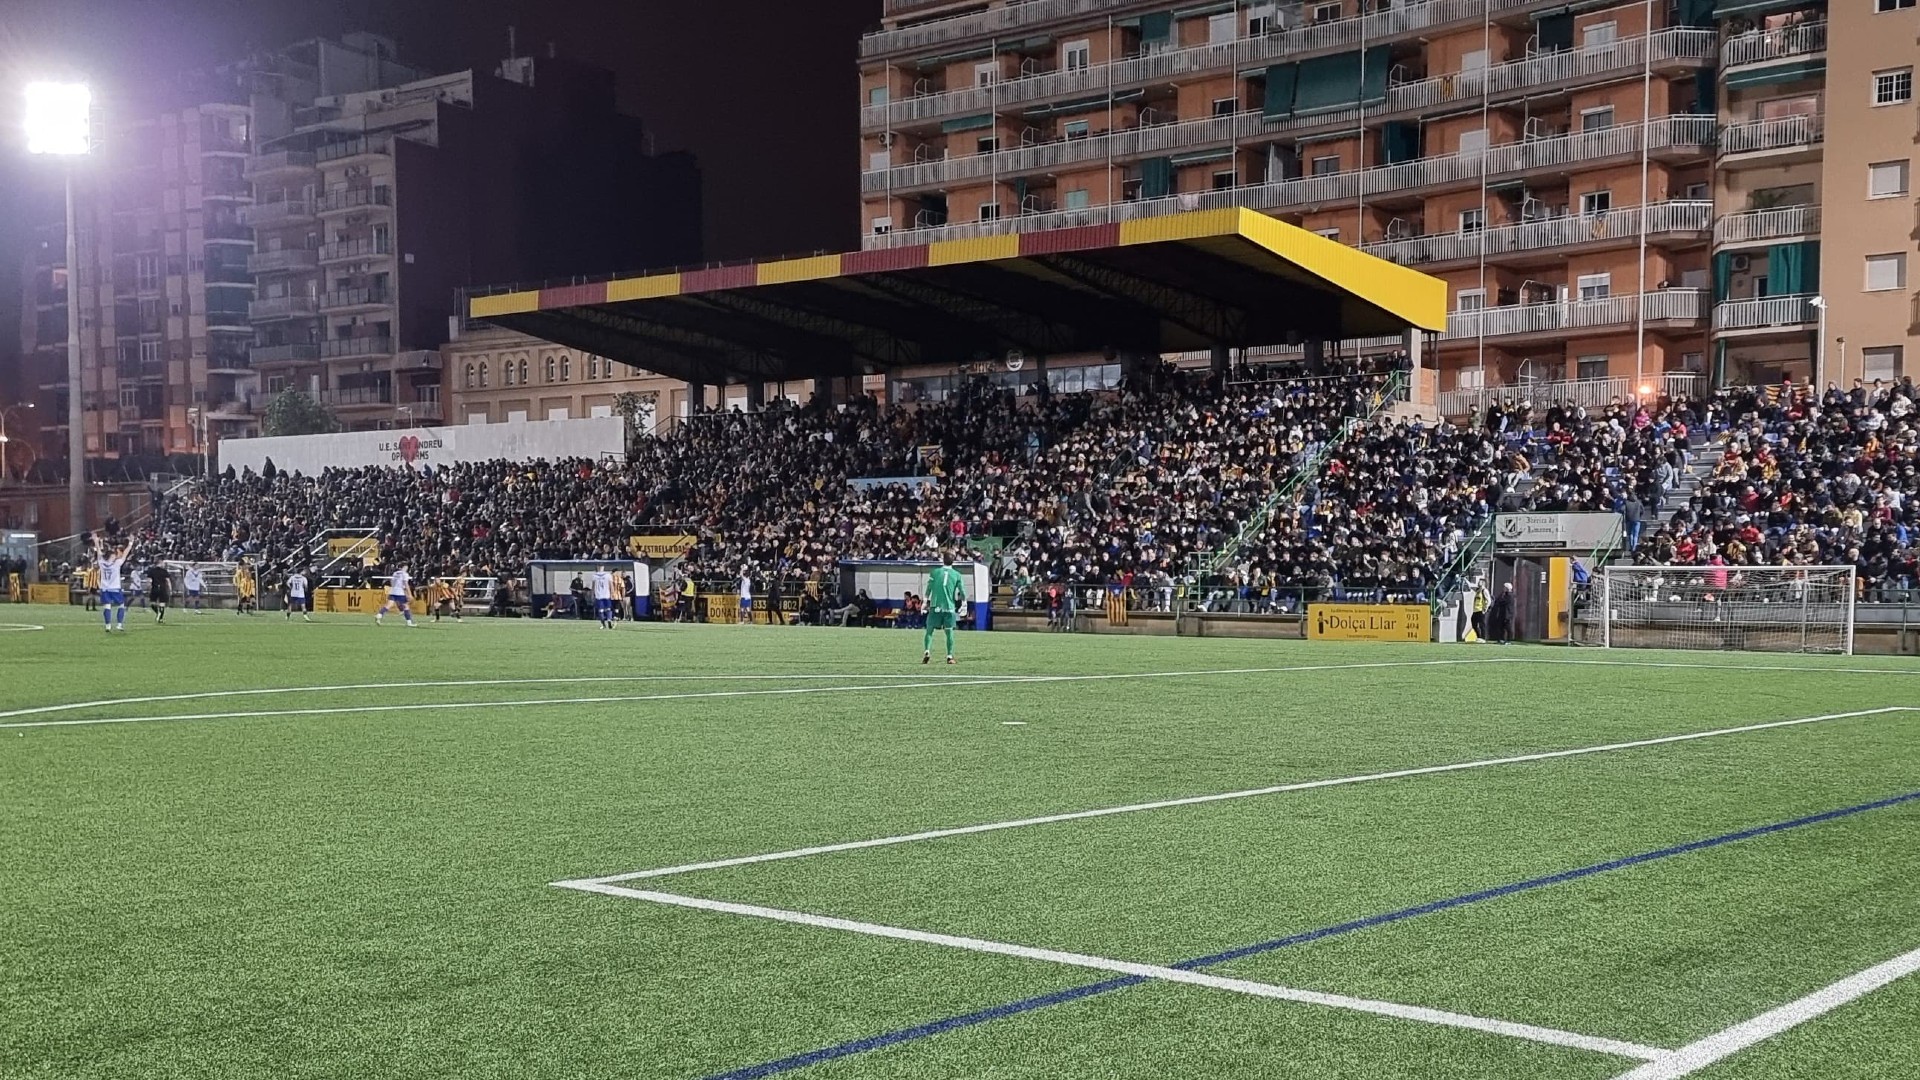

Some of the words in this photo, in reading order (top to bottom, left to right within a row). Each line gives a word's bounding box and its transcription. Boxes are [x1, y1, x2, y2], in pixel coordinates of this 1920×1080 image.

[379, 442, 392, 451] U.E.
[782, 600, 797, 611] 802
[1329, 615, 1366, 632] Dolça
[1370, 616, 1397, 630] Llar
[1405, 622, 1419, 630] 404
